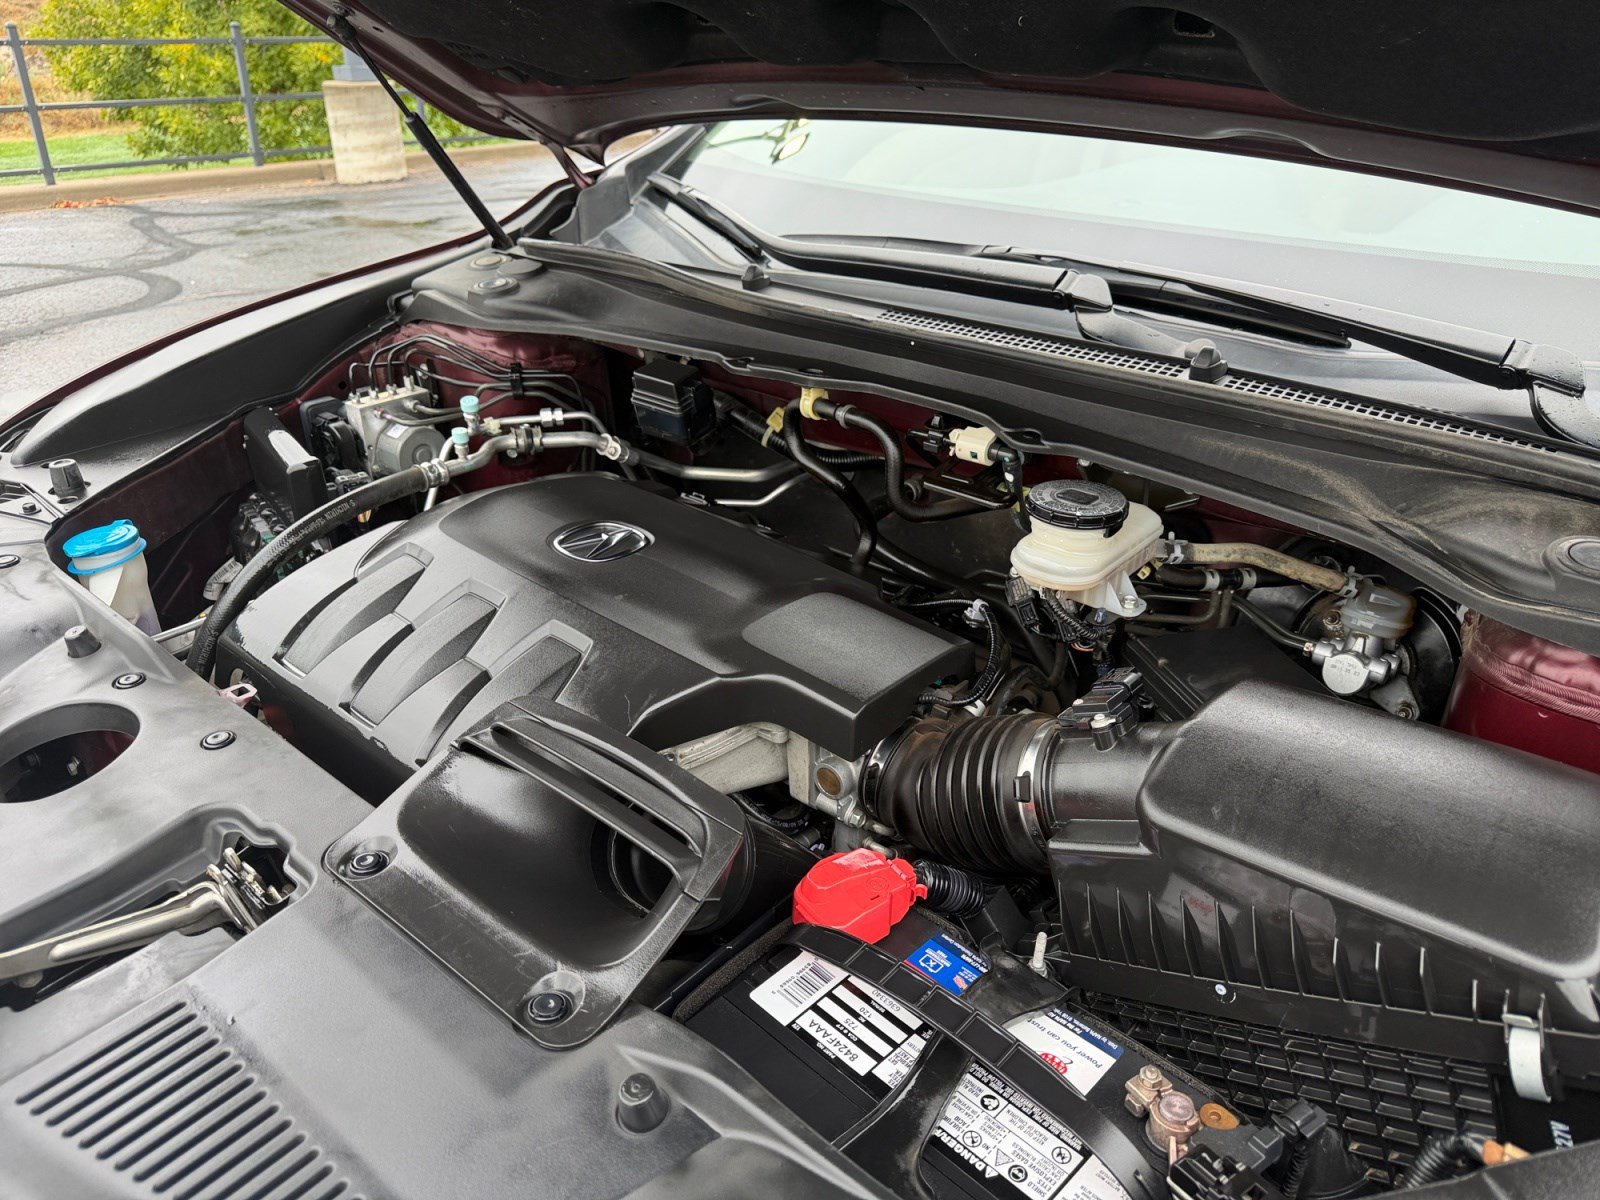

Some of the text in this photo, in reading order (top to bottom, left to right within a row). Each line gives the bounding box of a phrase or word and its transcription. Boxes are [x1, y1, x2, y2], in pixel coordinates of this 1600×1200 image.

[871, 987, 901, 1013] 6363340
[858, 1005, 873, 1018] 120
[843, 1017, 858, 1030] 725
[807, 1018, 859, 1063] 8424FAAA
[1026, 1017, 1103, 1069] Power you can trust
[968, 1087, 980, 1097] READ
[953, 1115, 966, 1127] ACID
[964, 1110, 973, 1119] CAN
[1005, 1107, 1027, 1127] CHILDREN
[1008, 1117, 1018, 1126] THE
[1023, 1128, 1033, 1137] OUT
[1032, 1128, 1048, 1142] REACH
[981, 1142, 990, 1150] NO
[1032, 1134, 1044, 1146] KEEP
[1011, 1141, 1061, 1181] CAN CAUSE BLINDNESS
[1011, 1149, 1056, 1186] EXPLOSIVE GASES
[1026, 1180, 1046, 1198] SHIELD
